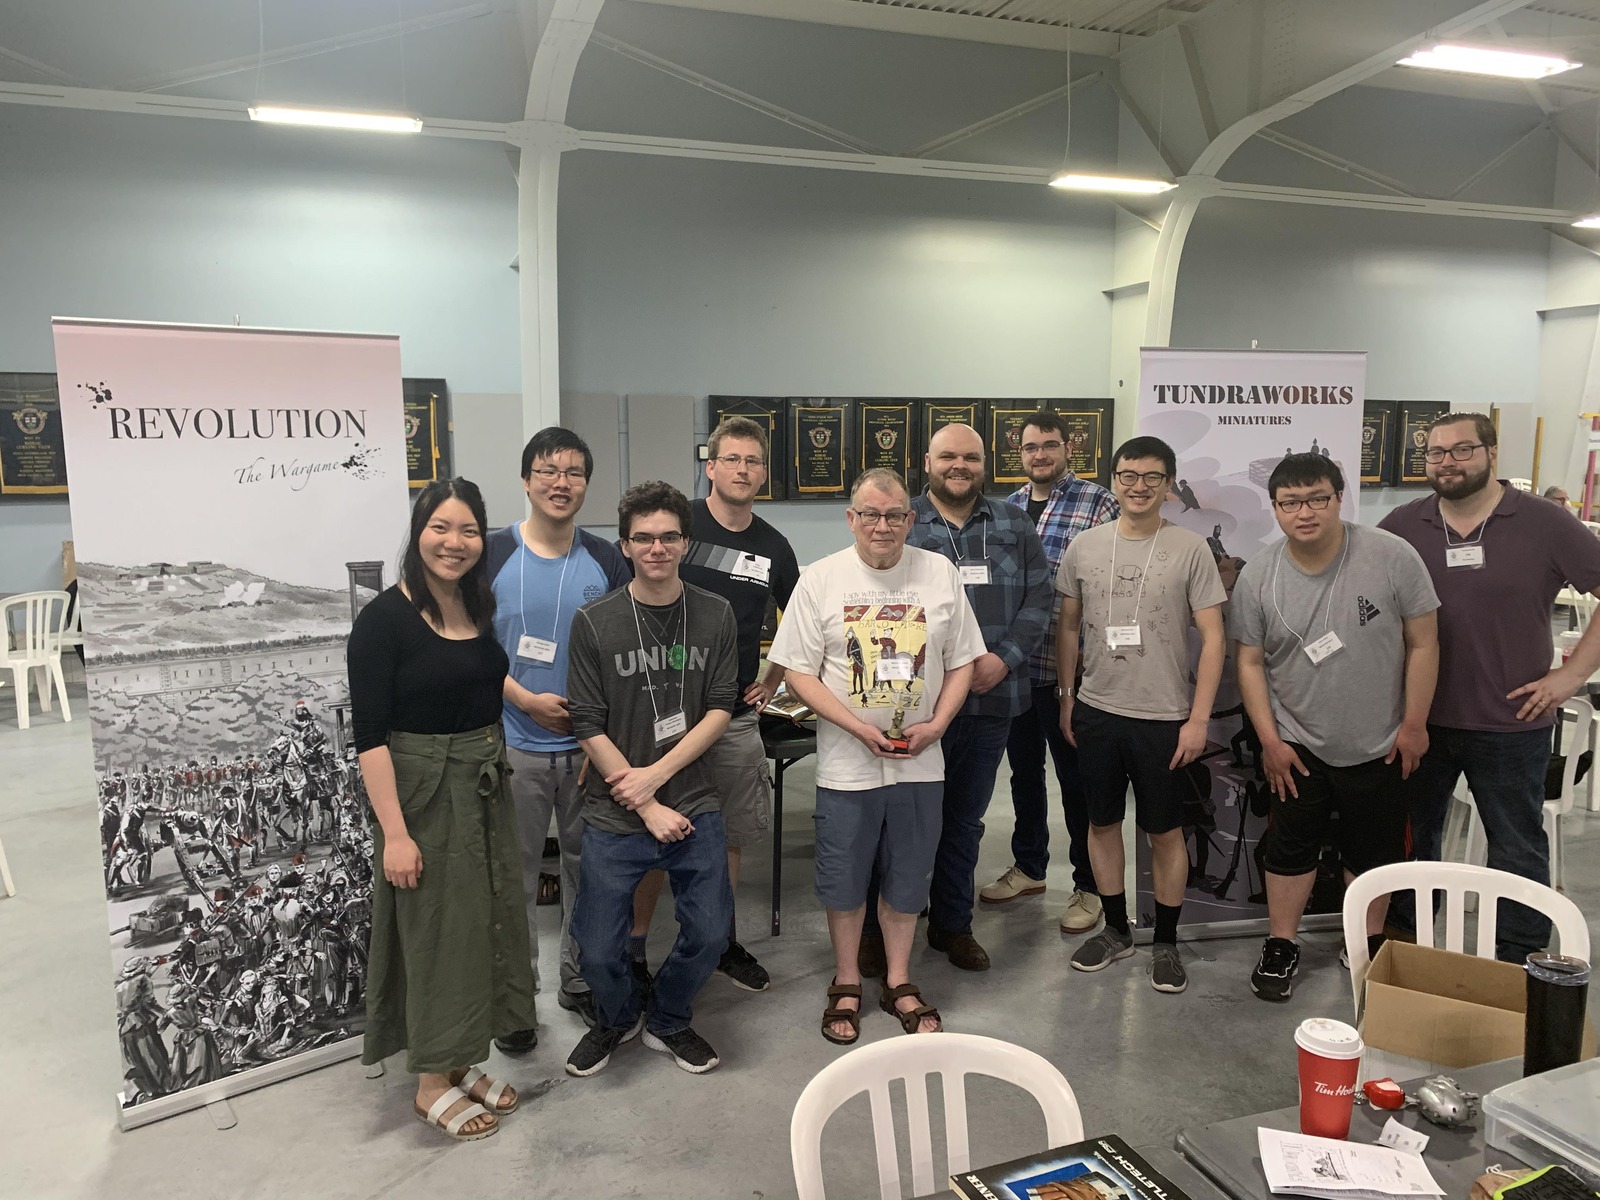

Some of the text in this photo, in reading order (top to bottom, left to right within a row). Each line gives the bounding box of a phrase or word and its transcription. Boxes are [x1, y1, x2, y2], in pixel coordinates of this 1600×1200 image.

[1154, 385, 1353, 405] TUNDRAWORKS
[107, 407, 367, 439] REVOLUTION
[1218, 416, 1292, 425] MINIATURES
[234, 456, 340, 491] The Wargame
[615, 645, 709, 677] UNION
[1314, 1081, 1334, 1096] Tim
